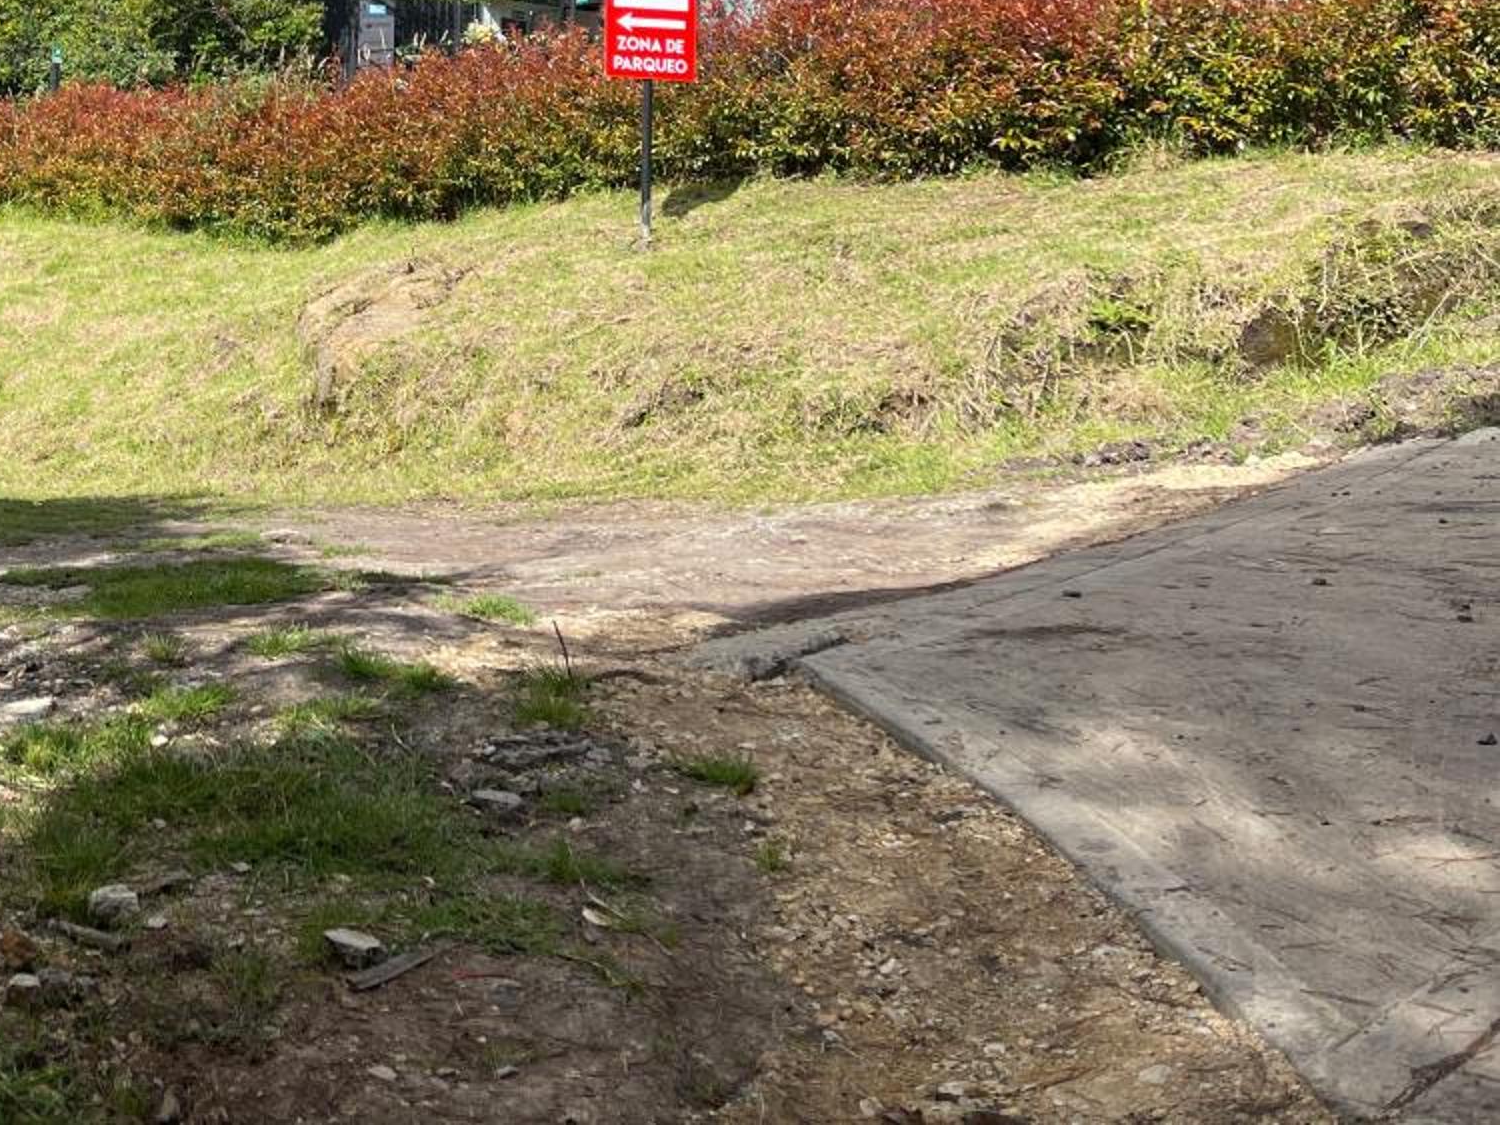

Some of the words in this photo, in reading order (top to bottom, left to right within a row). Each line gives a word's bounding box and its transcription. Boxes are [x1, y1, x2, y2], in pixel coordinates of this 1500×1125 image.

[617, 36, 662, 53] ZONA
[665, 38, 685, 54] DE
[613, 56, 688, 74] PARQUEO
